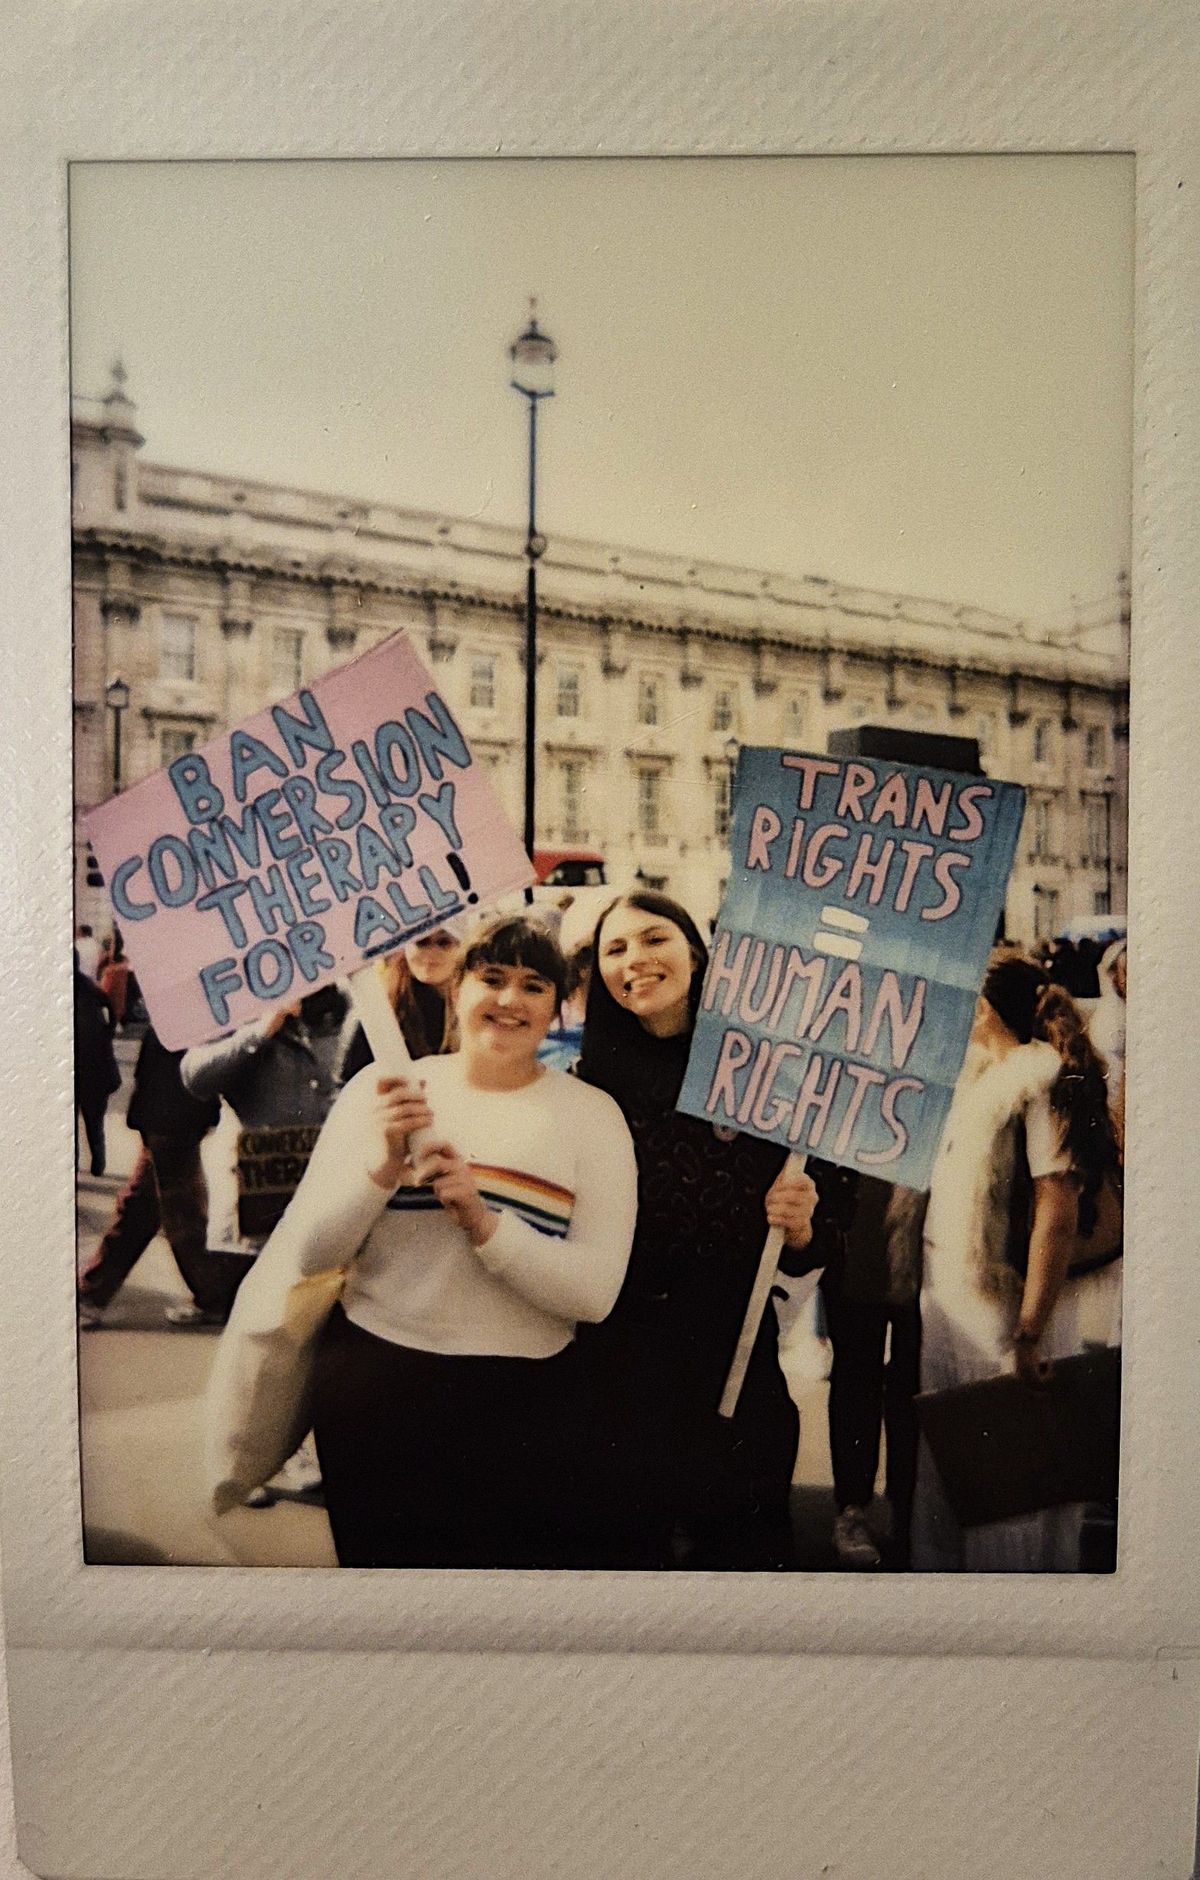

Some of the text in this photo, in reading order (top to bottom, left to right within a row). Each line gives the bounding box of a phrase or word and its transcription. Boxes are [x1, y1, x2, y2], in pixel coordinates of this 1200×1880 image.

[110, 692, 471, 921] CONVERSION
[169, 690, 335, 825] BAN
[781, 754, 993, 841] TRANS
[196, 782, 463, 949] THERAPY
[745, 805, 971, 921] RIGHTS
[200, 852, 479, 1026] FOR ALL!
[701, 931, 926, 1070] HUMAN
[705, 1029, 925, 1166] RIGHTS
